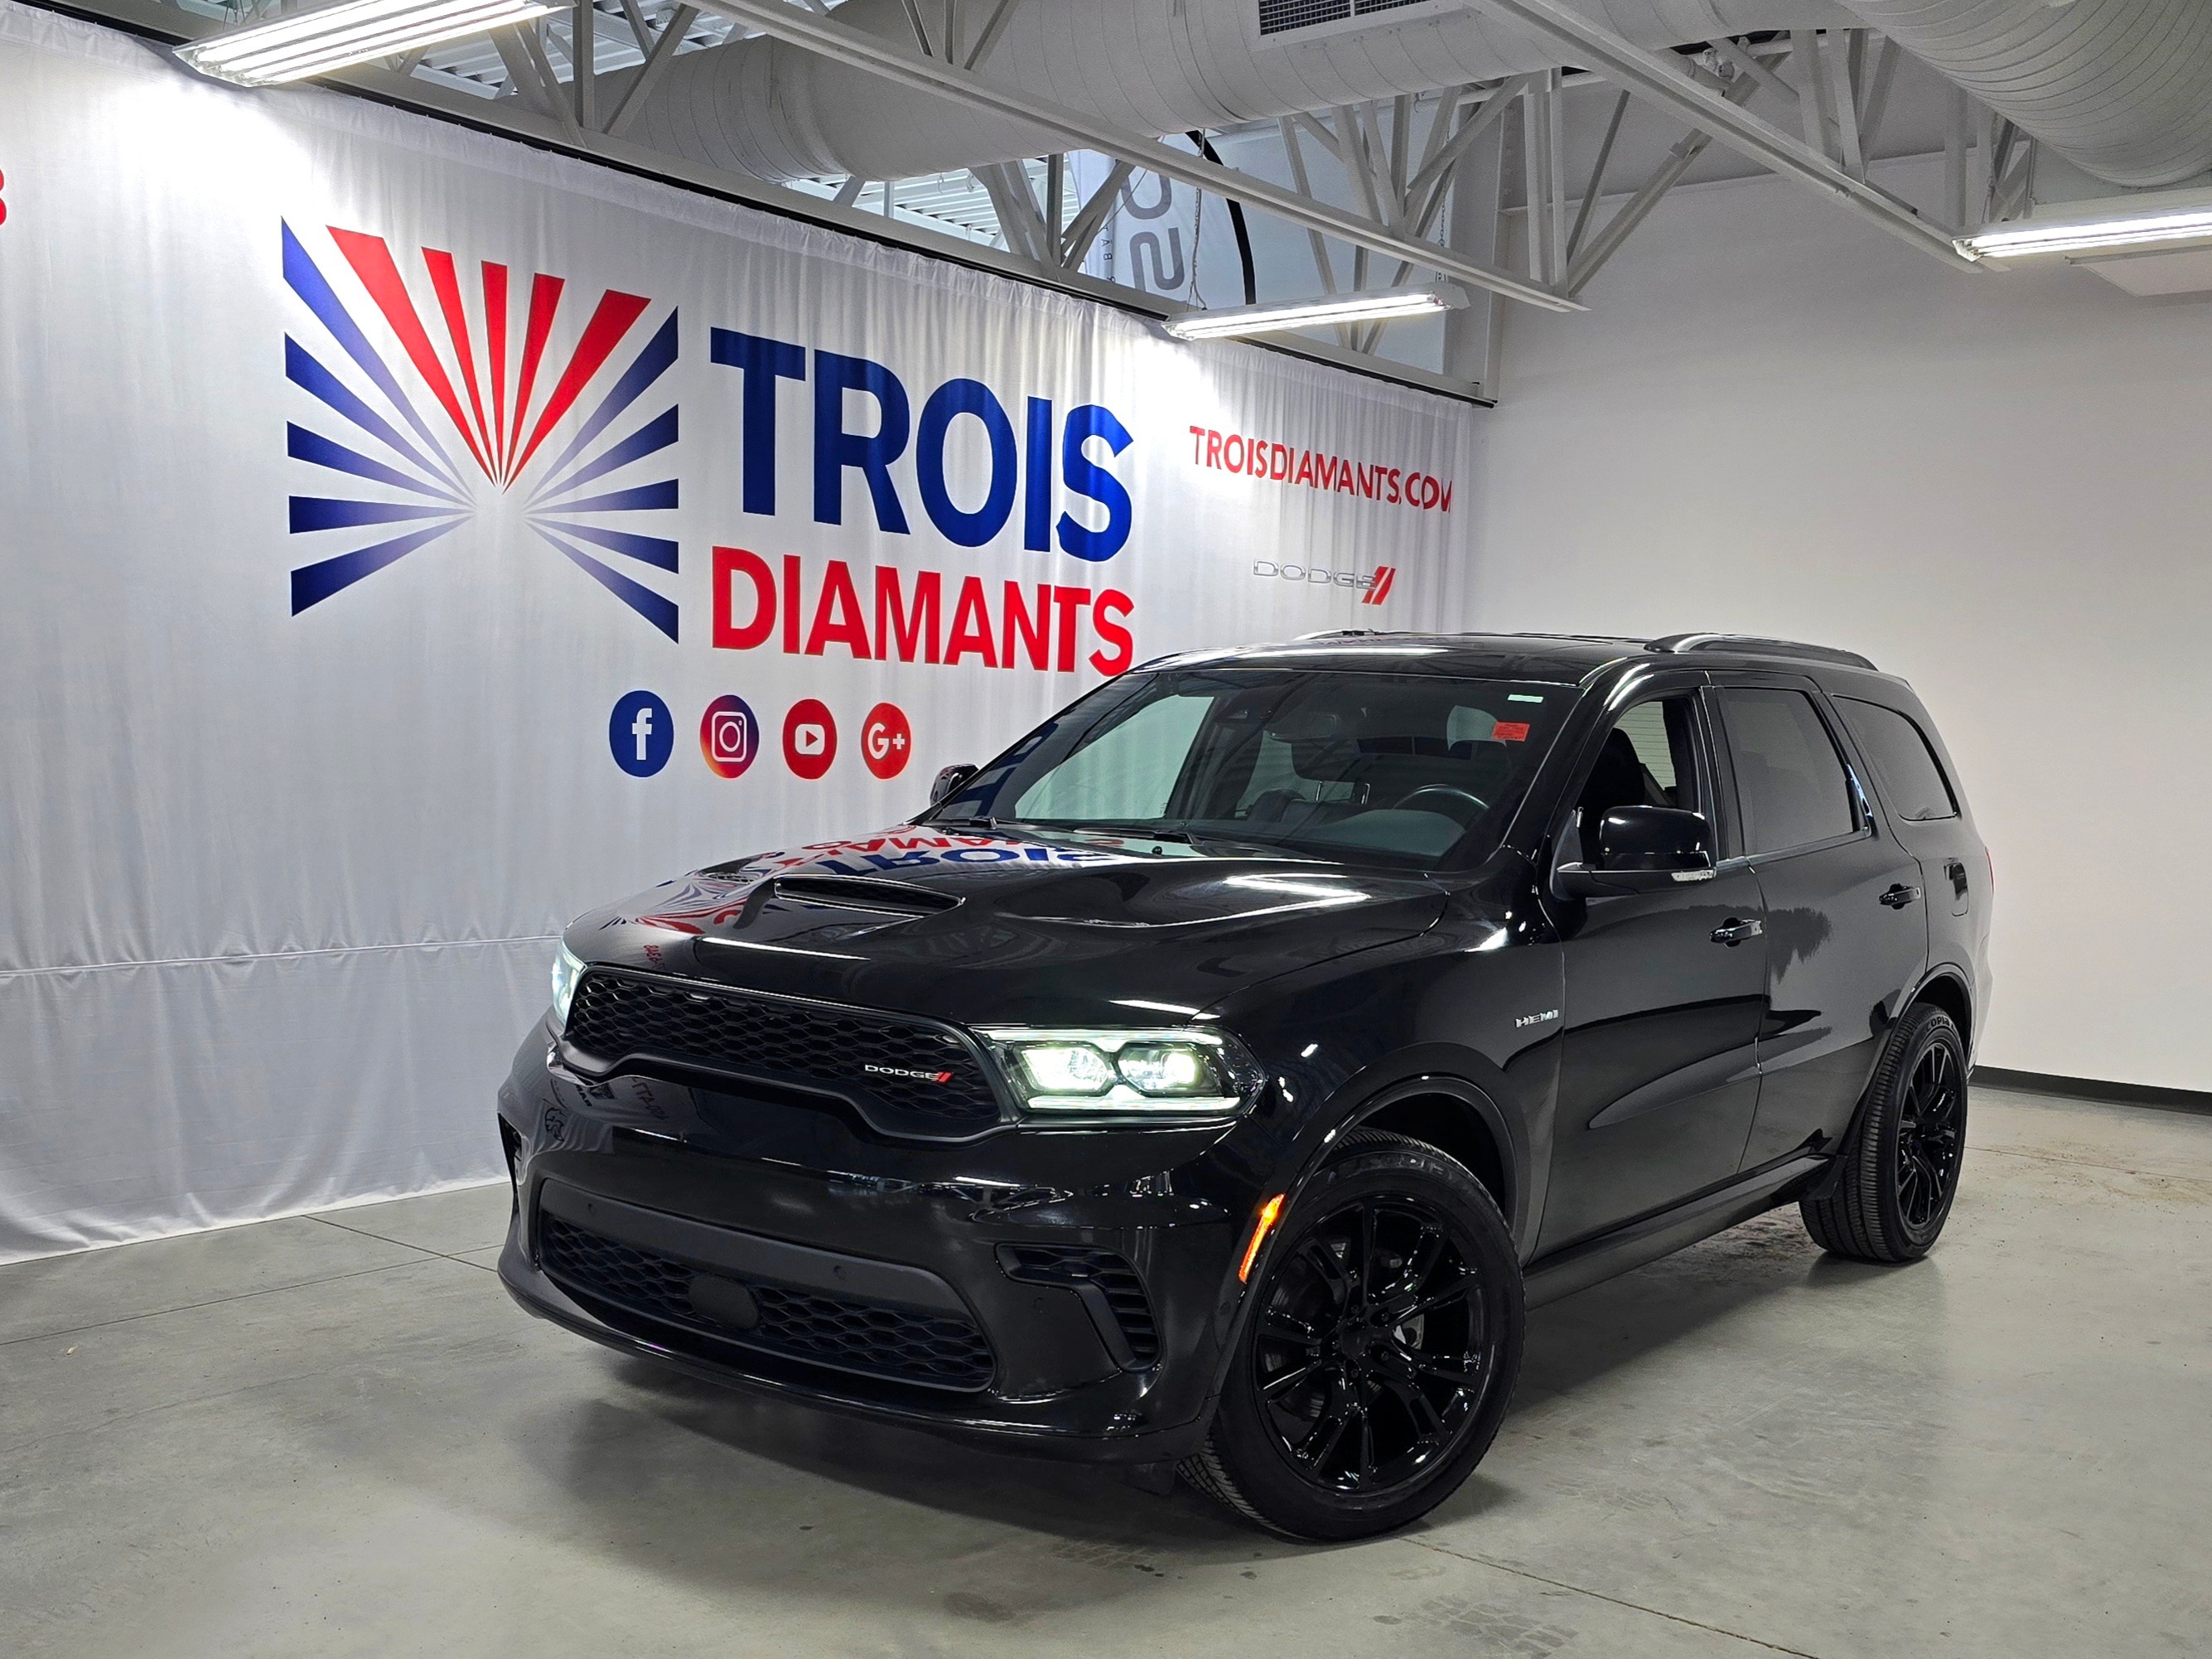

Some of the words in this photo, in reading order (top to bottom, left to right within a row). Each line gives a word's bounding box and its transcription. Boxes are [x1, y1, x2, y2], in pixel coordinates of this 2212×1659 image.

[710, 326, 1134, 563] TROIS
[1253, 560, 1377, 591] DODGE
[712, 545, 1134, 677] DIAMANTS
[1515, 1009, 1558, 1028] HEMI
[865, 1064, 939, 1081] DODGE
